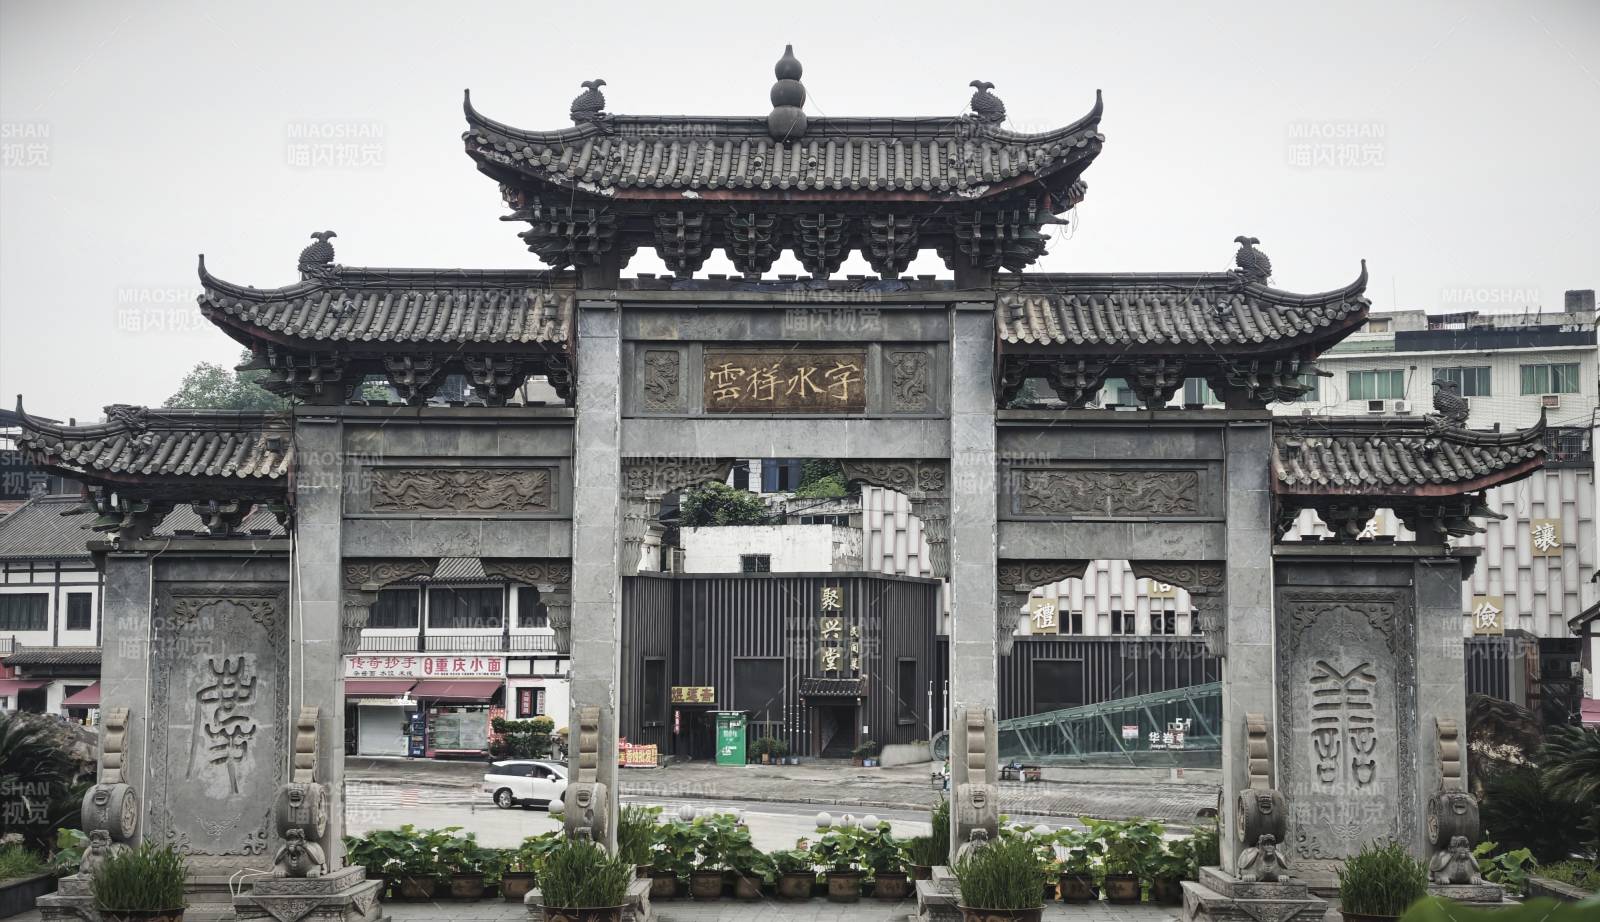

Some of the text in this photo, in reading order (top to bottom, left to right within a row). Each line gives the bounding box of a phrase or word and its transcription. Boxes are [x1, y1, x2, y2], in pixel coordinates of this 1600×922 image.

[1530, 522, 1561, 552] 讓
[1032, 602, 1057, 629] 禮
[1473, 601, 1503, 629] 儉
[820, 587, 842, 671] 聚兴堂
[350, 656, 417, 669] 传奇抄手
[435, 657, 501, 673] 重庆小面
